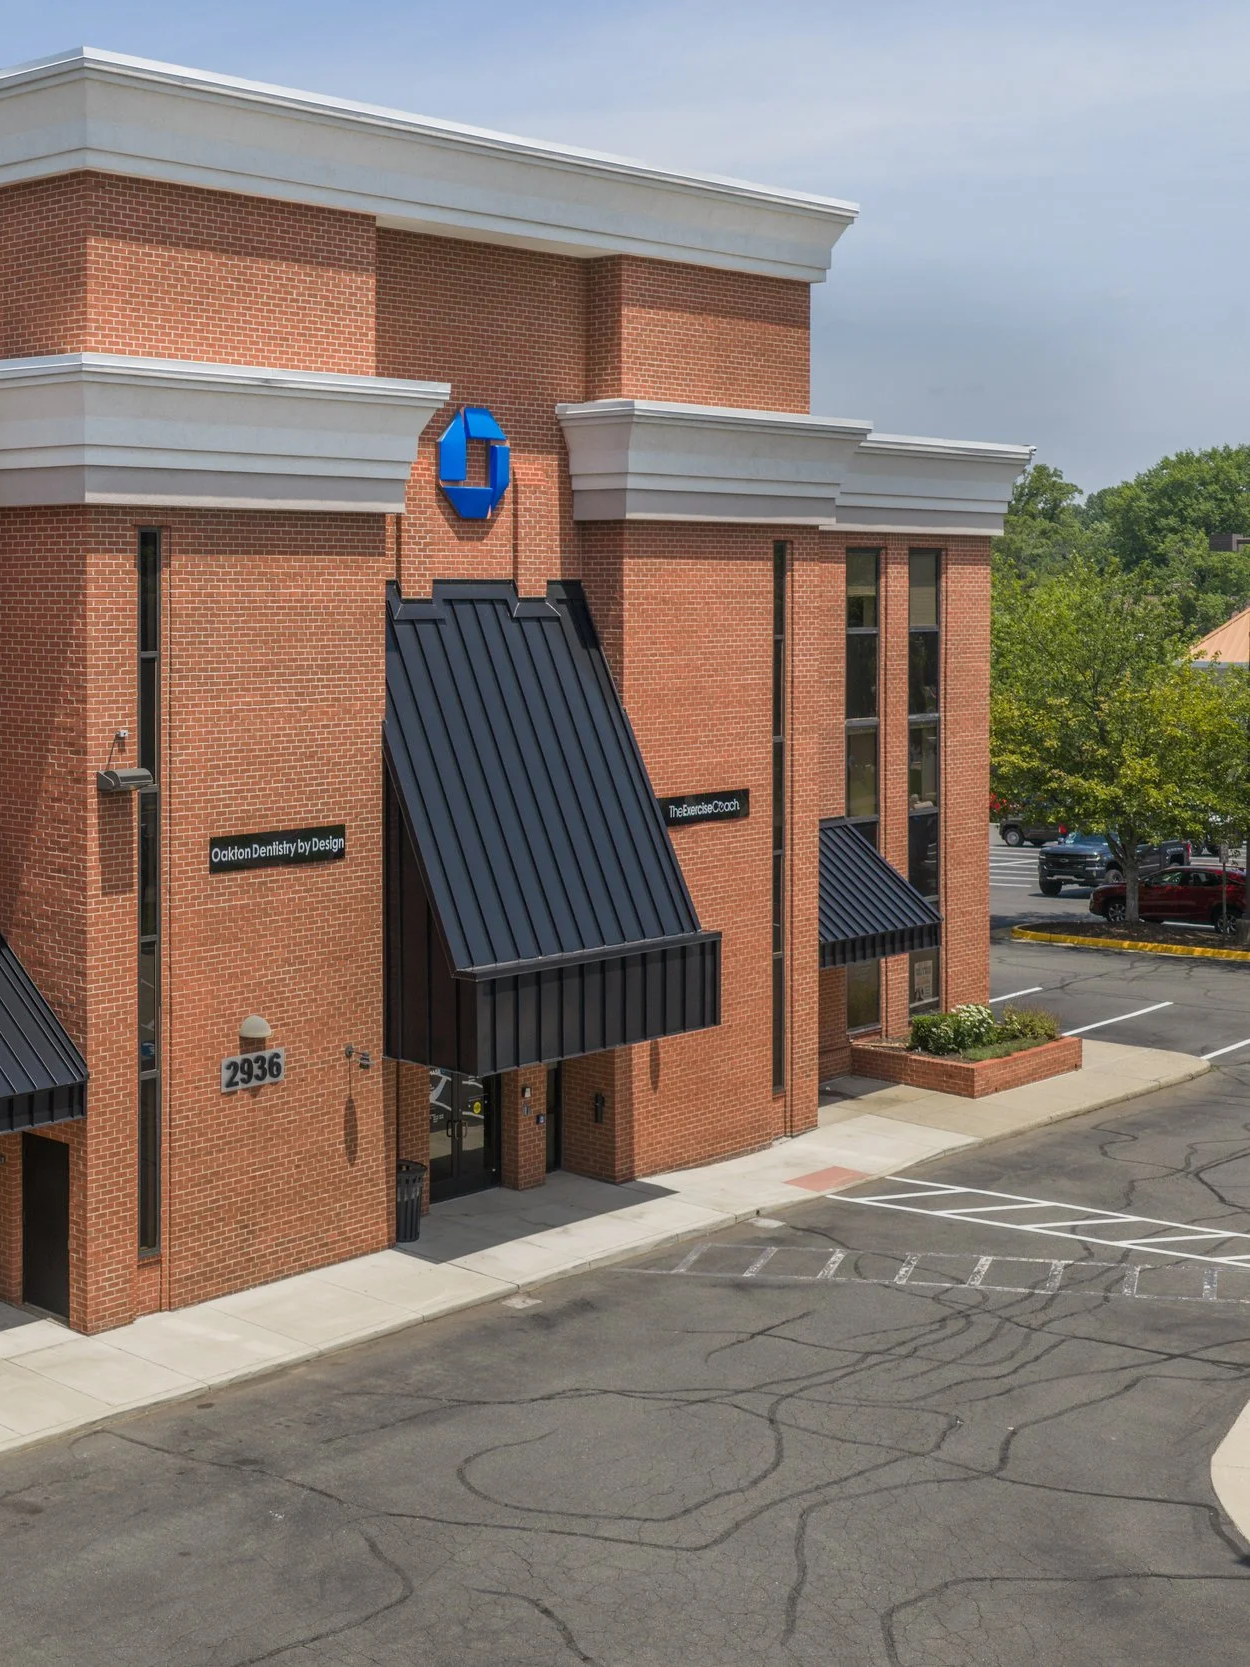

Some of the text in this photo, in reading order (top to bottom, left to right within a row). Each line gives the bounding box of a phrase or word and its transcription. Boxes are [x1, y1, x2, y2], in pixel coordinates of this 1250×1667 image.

[211, 835, 345, 863] Oakton Dentistry by Design
[225, 1052, 282, 1088] 2936
